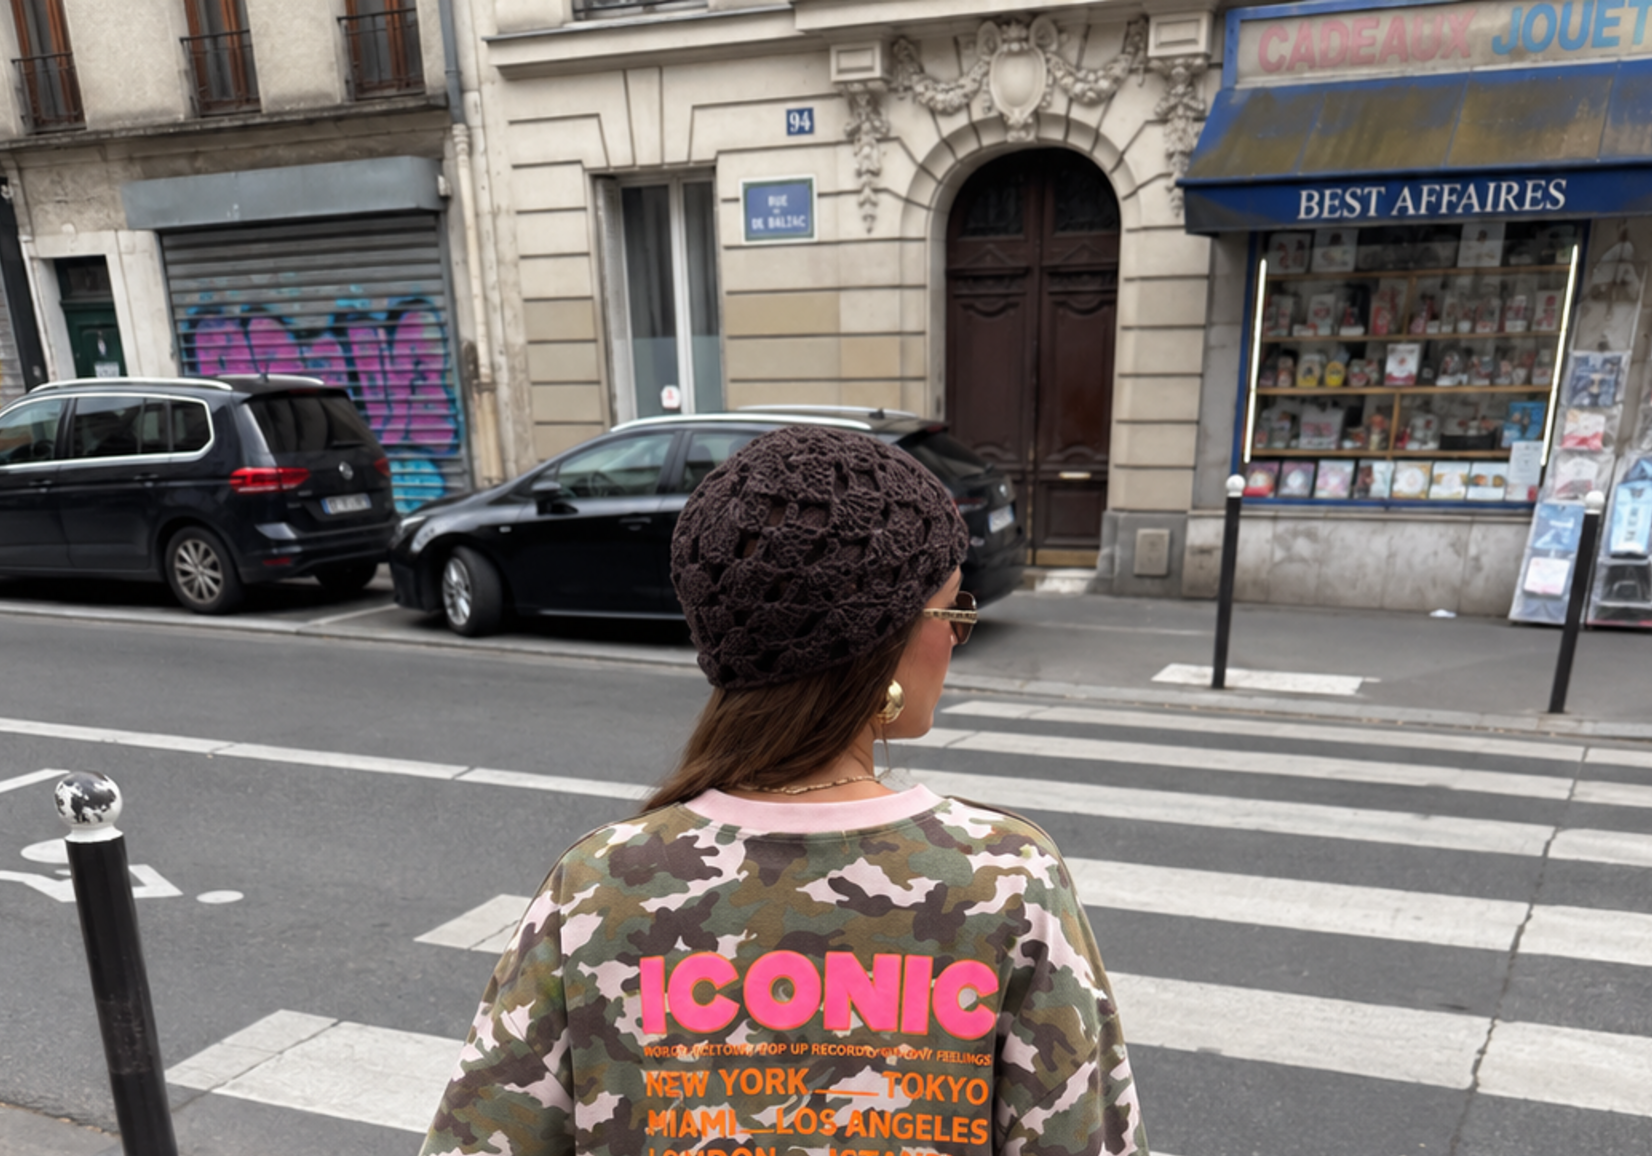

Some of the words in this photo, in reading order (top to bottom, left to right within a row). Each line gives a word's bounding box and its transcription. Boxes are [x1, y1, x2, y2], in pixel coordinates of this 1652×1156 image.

[1258, 8, 1477, 73] CADEAUX
[1491, 0, 1652, 55] JOUET
[789, 110, 812, 133] 94
[768, 194, 788, 207] RUE
[1297, 186, 1385, 220] BEST
[1391, 178, 1567, 216] AFFAIRES
[751, 217, 765, 231] DE
[768, 215, 806, 230] BALZAC
[639, 950, 999, 1040] ICONIC
[790, 1043, 809, 1055] UP
[645, 1071, 710, 1098] NEW
[719, 1068, 810, 1096] YORK
[882, 1071, 990, 1106] TOKYO
[646, 1109, 738, 1139] MIAMI
[776, 1107, 838, 1136] LOS
[846, 1110, 989, 1145] ANGELES
